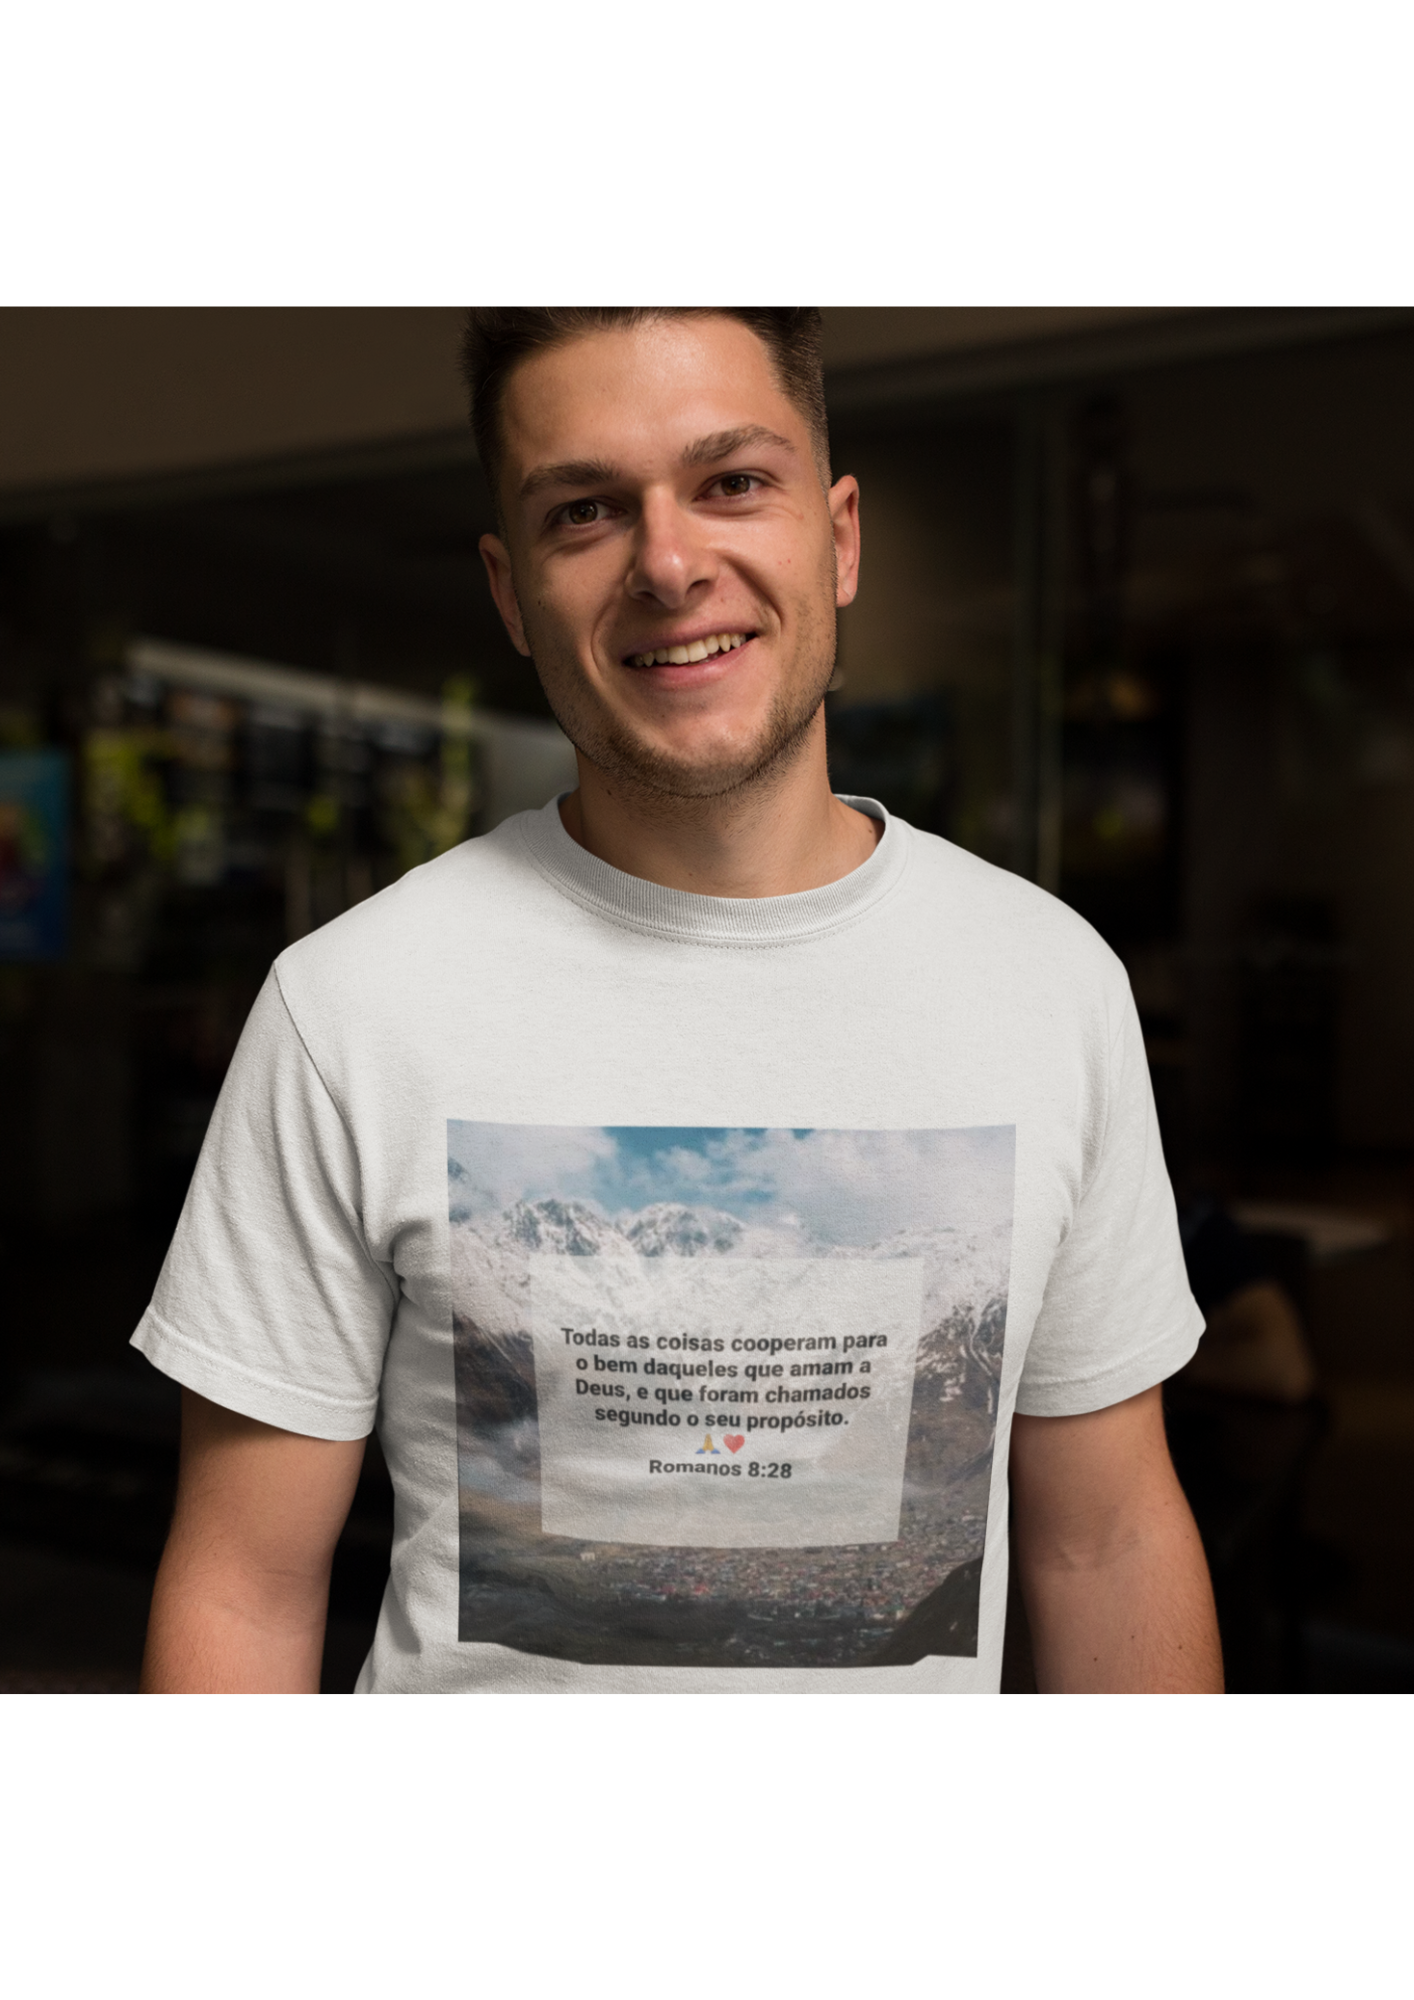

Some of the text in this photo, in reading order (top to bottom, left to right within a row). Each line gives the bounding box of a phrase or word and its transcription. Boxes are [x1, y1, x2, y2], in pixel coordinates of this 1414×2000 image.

[561, 1328, 887, 1355] Todas as coisas cooperam para
[576, 1355, 871, 1381] o bem daqueles que amam a
[576, 1379, 871, 1404] Deus, e que foram chamados
[595, 1407, 850, 1432] segundo o seu propósito.
[649, 1460, 792, 1479] Romanos 8:28
